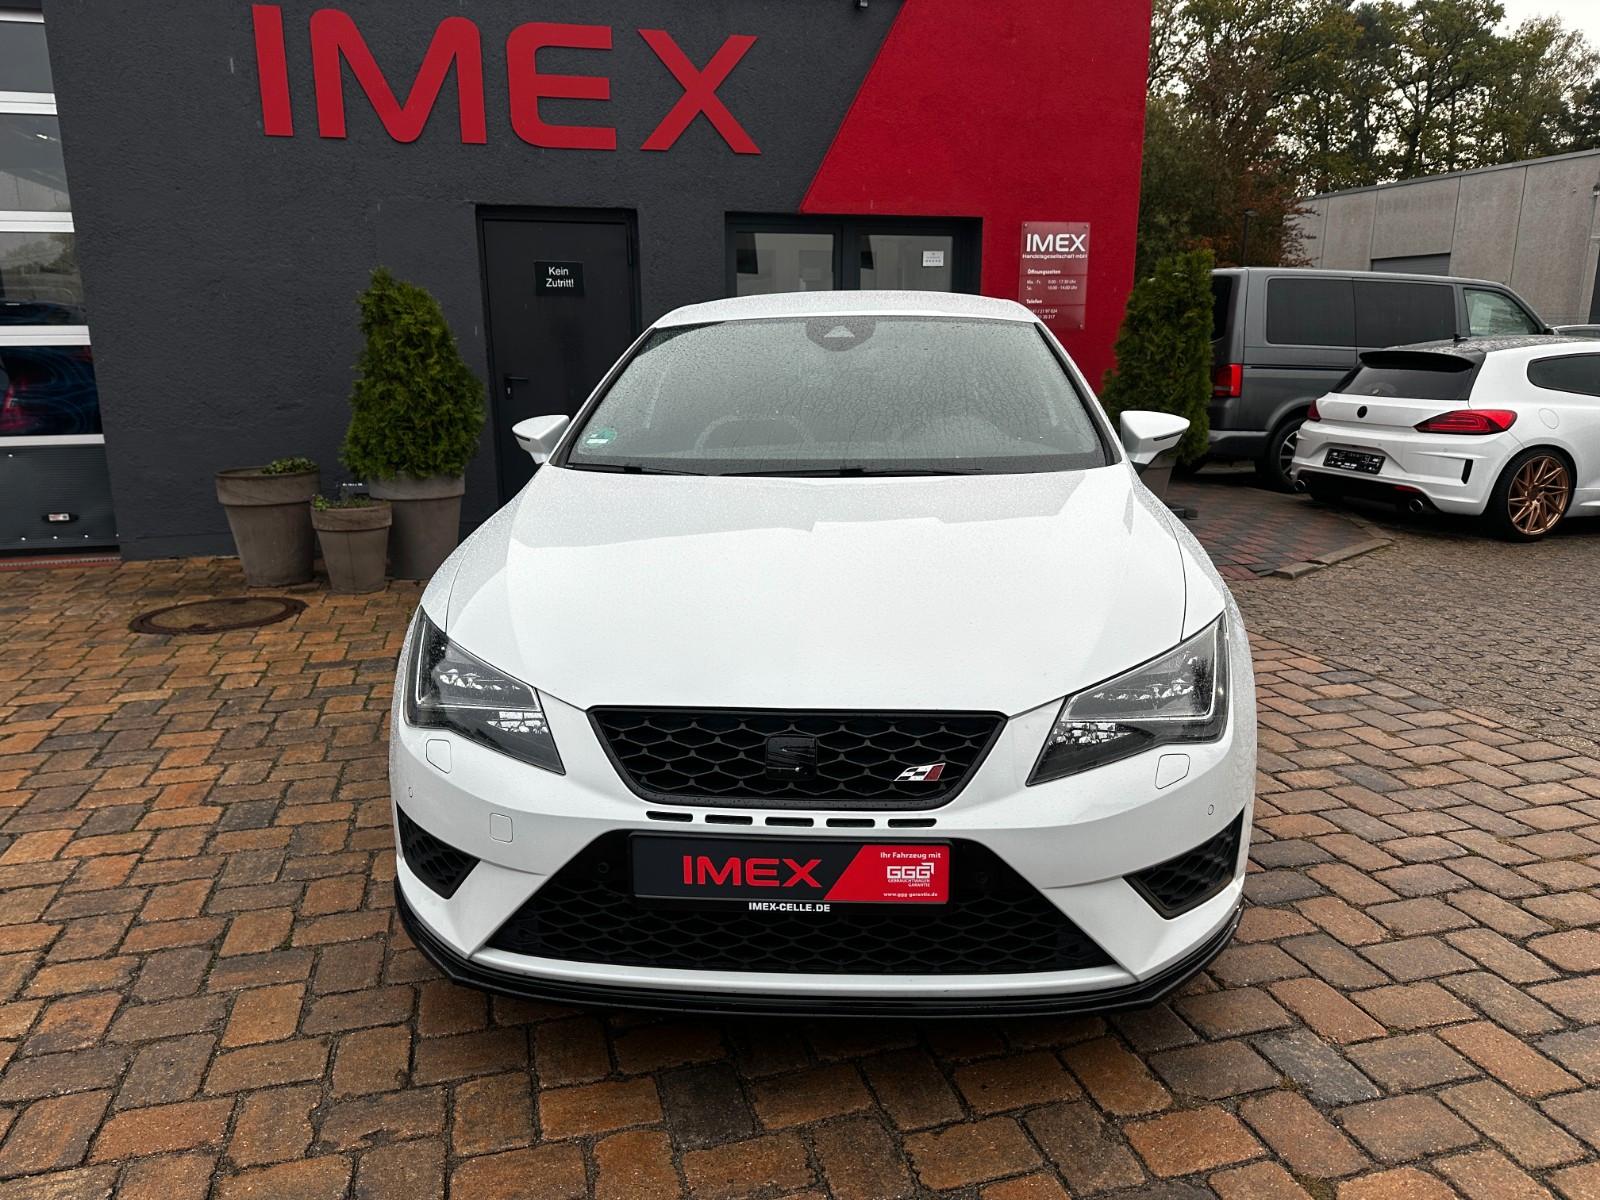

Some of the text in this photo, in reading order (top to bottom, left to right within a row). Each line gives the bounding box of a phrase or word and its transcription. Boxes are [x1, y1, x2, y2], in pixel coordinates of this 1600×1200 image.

[252, 4, 761, 155] IMEX
[1026, 234, 1086, 251] IMEX
[548, 266, 569, 276] Kein
[545, 278, 575, 288] Zutritt!
[880, 851, 941, 860] Ihr Fahrzeug mit
[682, 855, 823, 888] IMEX
[887, 865, 931, 879] GGG
[748, 902, 831, 912] IMEX-CELLE.DE
